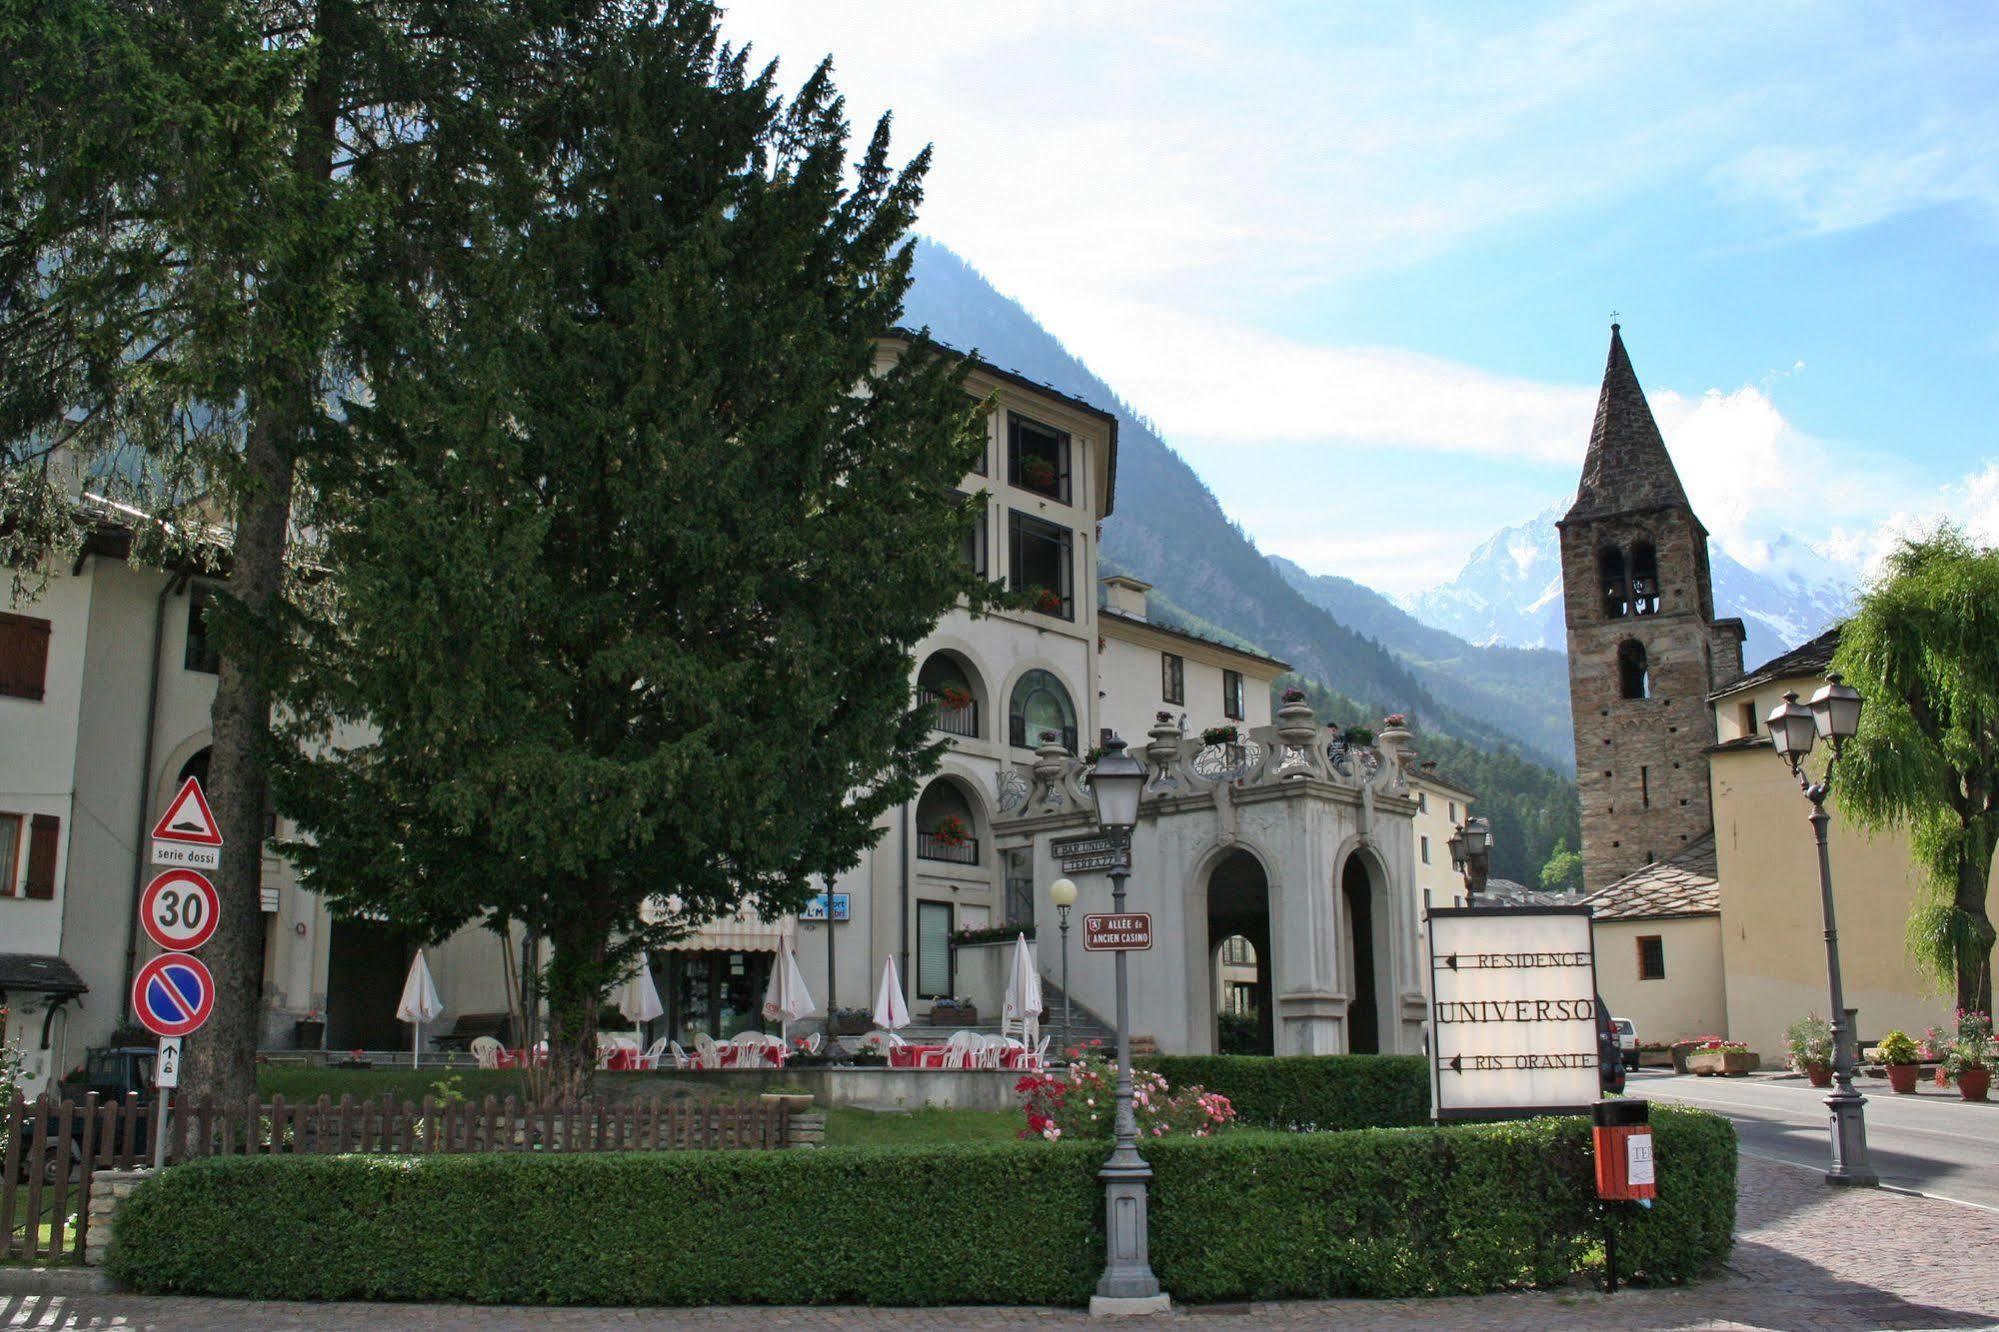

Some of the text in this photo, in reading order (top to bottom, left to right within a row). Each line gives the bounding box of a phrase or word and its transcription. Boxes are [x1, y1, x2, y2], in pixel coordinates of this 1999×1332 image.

[158, 849, 214, 864] serie dossi
[159, 890, 203, 929] 30
[1108, 918, 1131, 929] ALLÉE
[1121, 933, 1148, 943] CASINO
[1478, 952, 1585, 969] RESIDENCE
[1439, 999, 1593, 1023] UNIVERSO
[1633, 1146, 1651, 1160] TE
